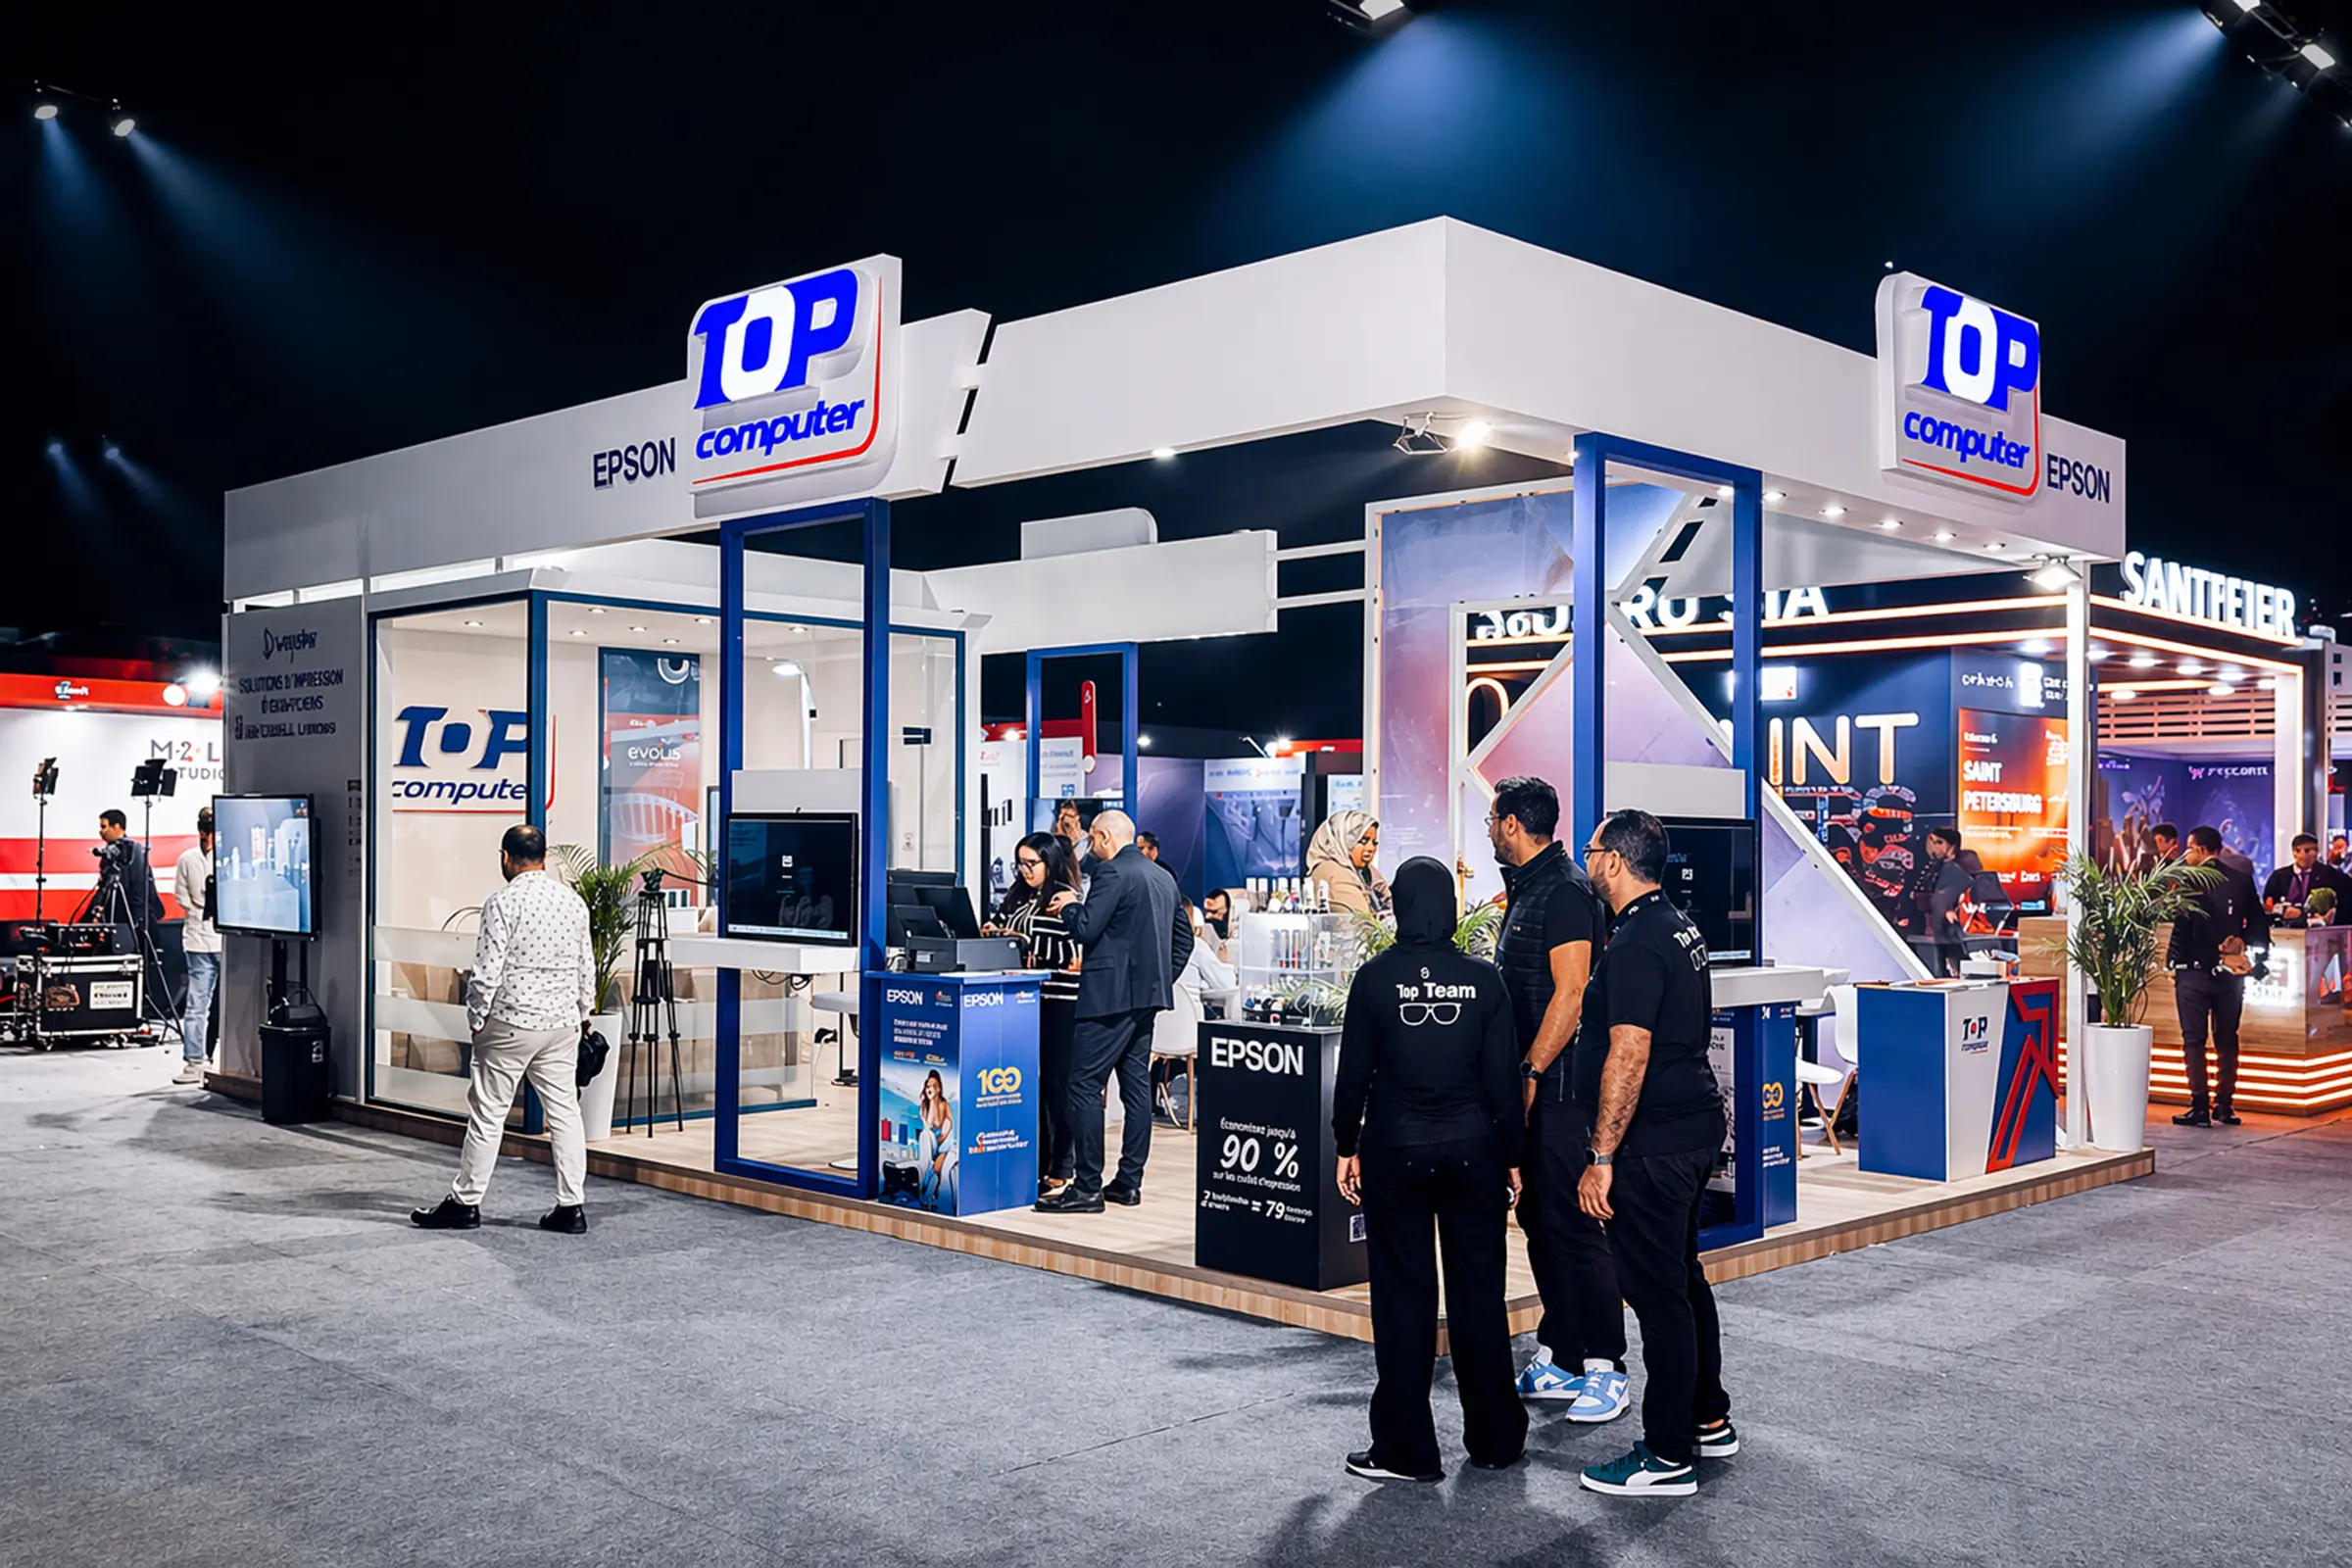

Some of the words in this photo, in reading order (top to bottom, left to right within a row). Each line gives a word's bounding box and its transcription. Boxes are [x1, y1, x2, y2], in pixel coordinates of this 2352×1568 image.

[693, 269, 858, 410] TOP
[1921, 285, 2039, 412] TOP
[695, 398, 865, 460] computer
[1903, 411, 2031, 468] computer
[593, 437, 676, 489] EPSON
[2047, 454, 2111, 504] EPSON
[177, 766, 223, 780] TUDI
[392, 778, 527, 806] compute
[886, 989, 924, 1005] EPSON
[964, 992, 1004, 1007] EPSON
[1396, 984, 1419, 1002] Top
[1423, 982, 1477, 999] Team
[1210, 1037, 1304, 1076] EPSON
[1220, 1134, 1260, 1172] 90
[1274, 1142, 1298, 1179] %
[1265, 1200, 1286, 1219] 79
